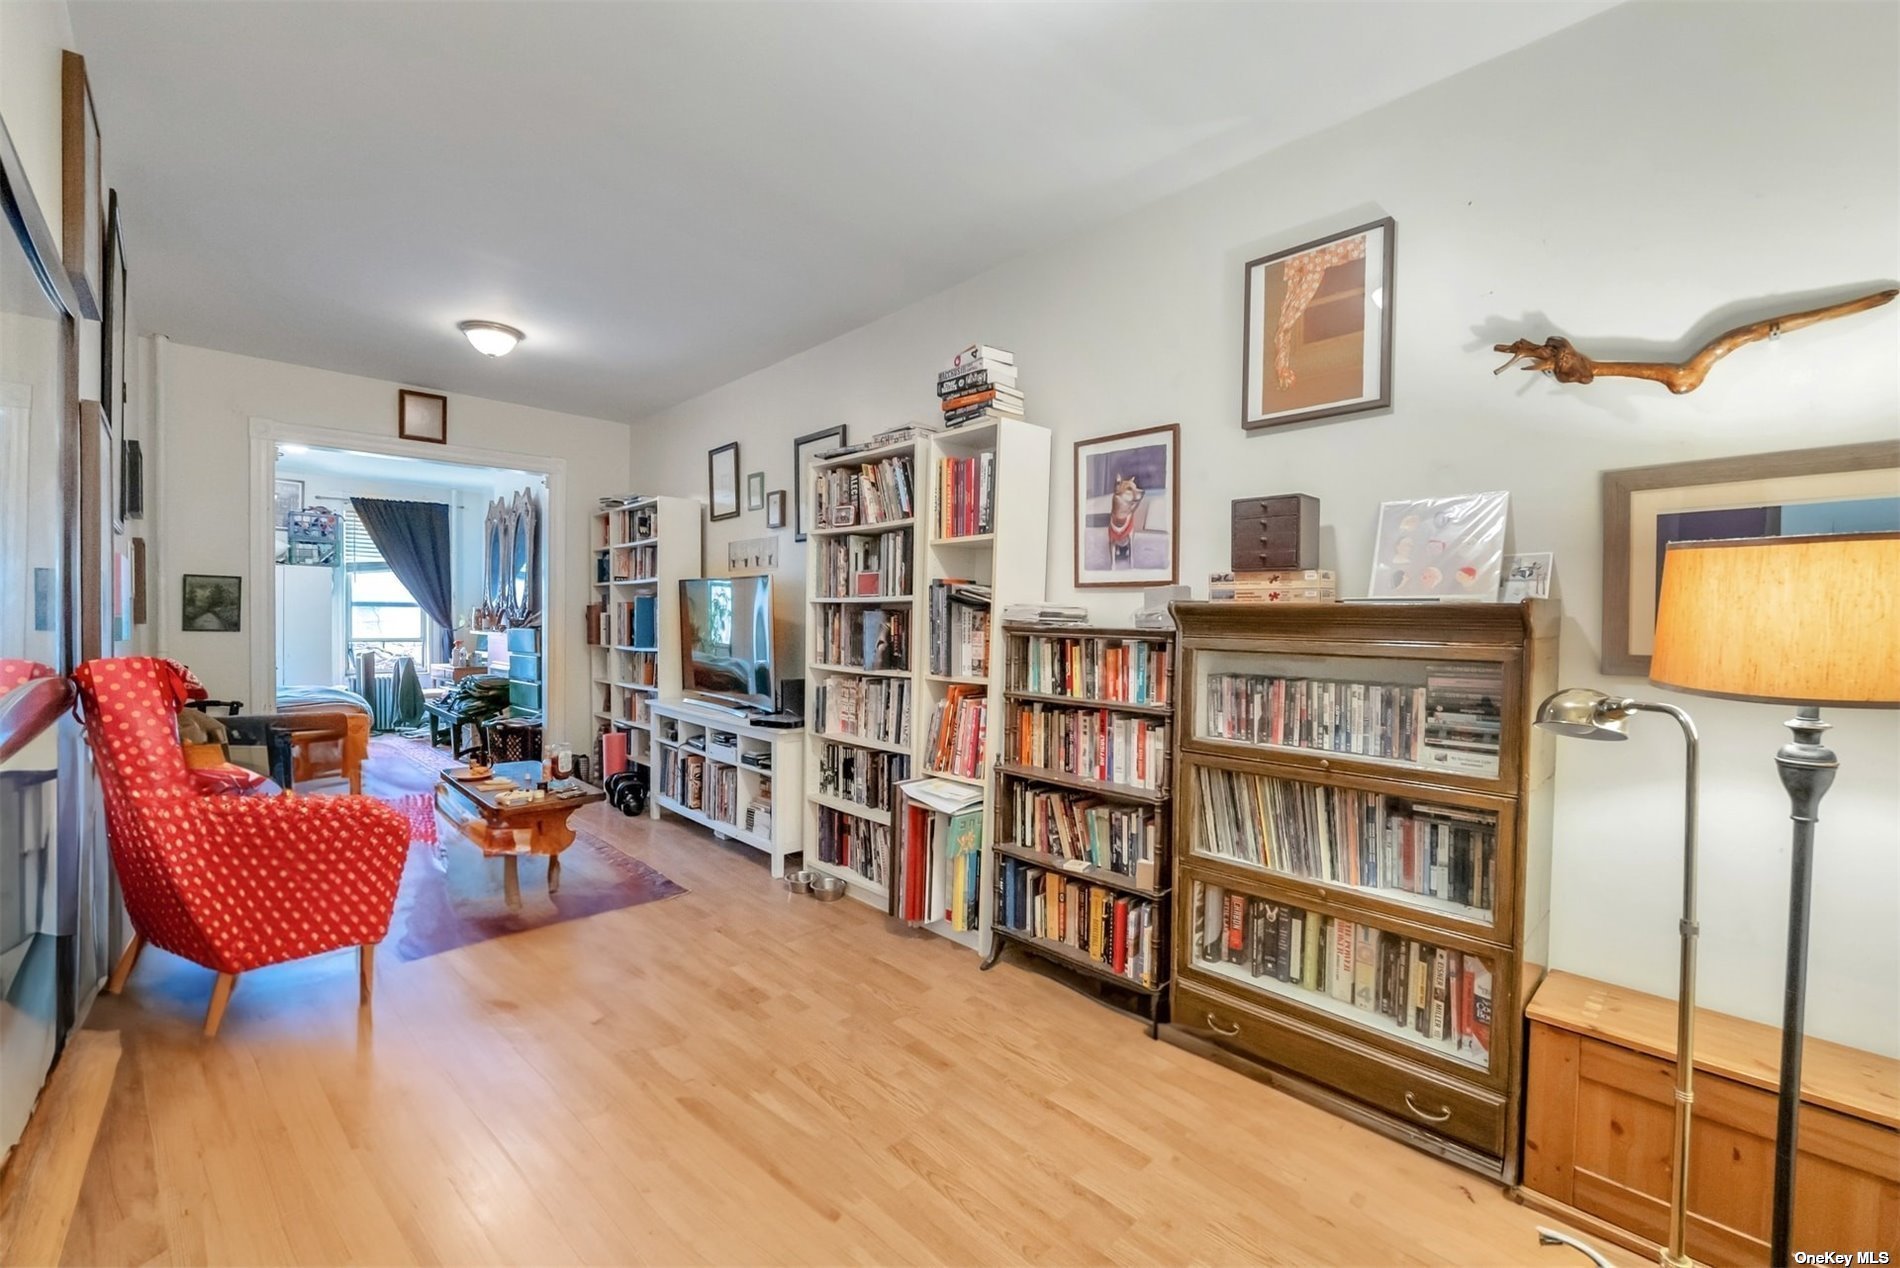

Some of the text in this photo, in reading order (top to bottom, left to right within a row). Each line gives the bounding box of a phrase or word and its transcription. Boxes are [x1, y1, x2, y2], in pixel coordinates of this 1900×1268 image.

[850, 475, 859, 495] ALEC
[1435, 961, 1446, 1028] EISNER MILLER
